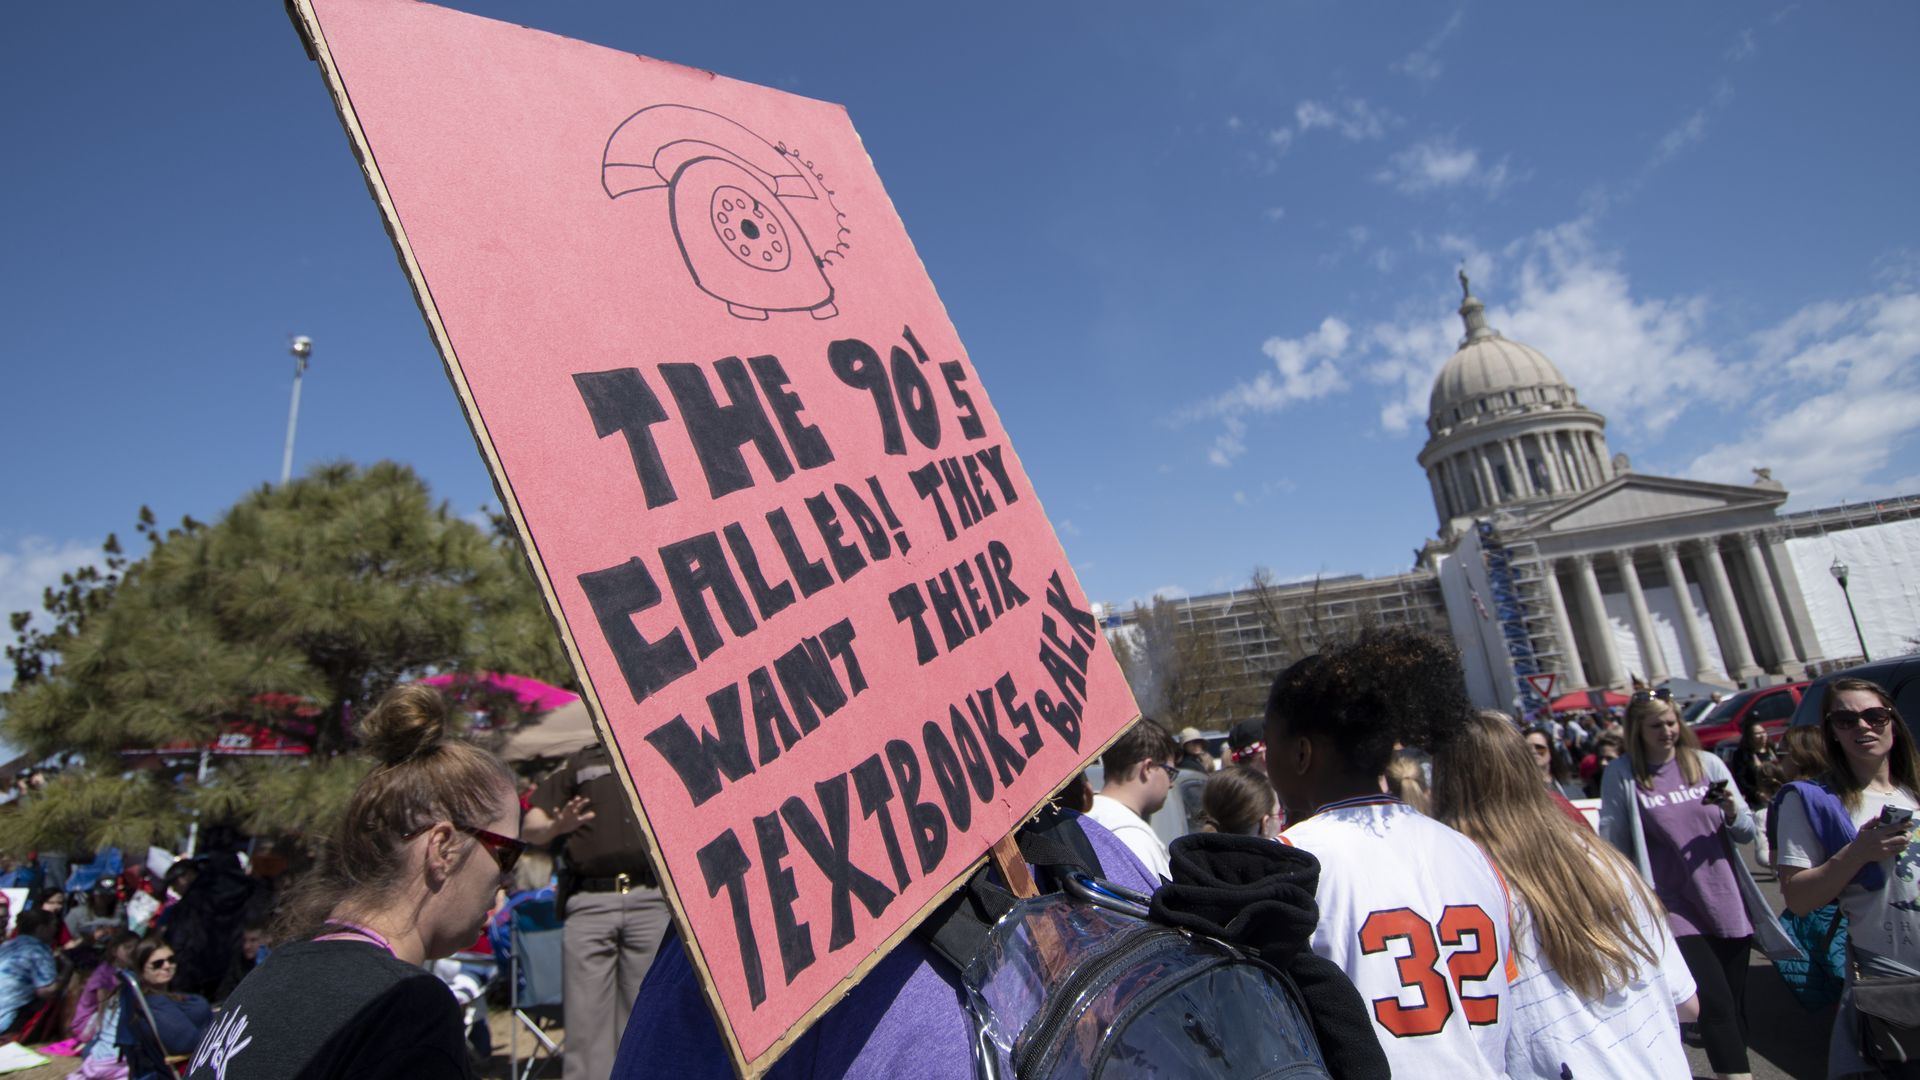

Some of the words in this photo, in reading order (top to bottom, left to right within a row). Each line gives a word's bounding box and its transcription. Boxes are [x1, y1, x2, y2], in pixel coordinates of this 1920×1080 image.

[572, 355, 834, 509] THE
[828, 326, 985, 455] 90'S
[577, 476, 911, 704] CALLED!
[909, 445, 1017, 540] THEY
[644, 618, 868, 807] WANT
[889, 541, 1029, 665] THEIR
[697, 672, 1043, 1011] TEXTBOOKS
[1034, 569, 1096, 754] BACK
[1639, 792, 1667, 809] be
[1358, 904, 1499, 1038] 32
